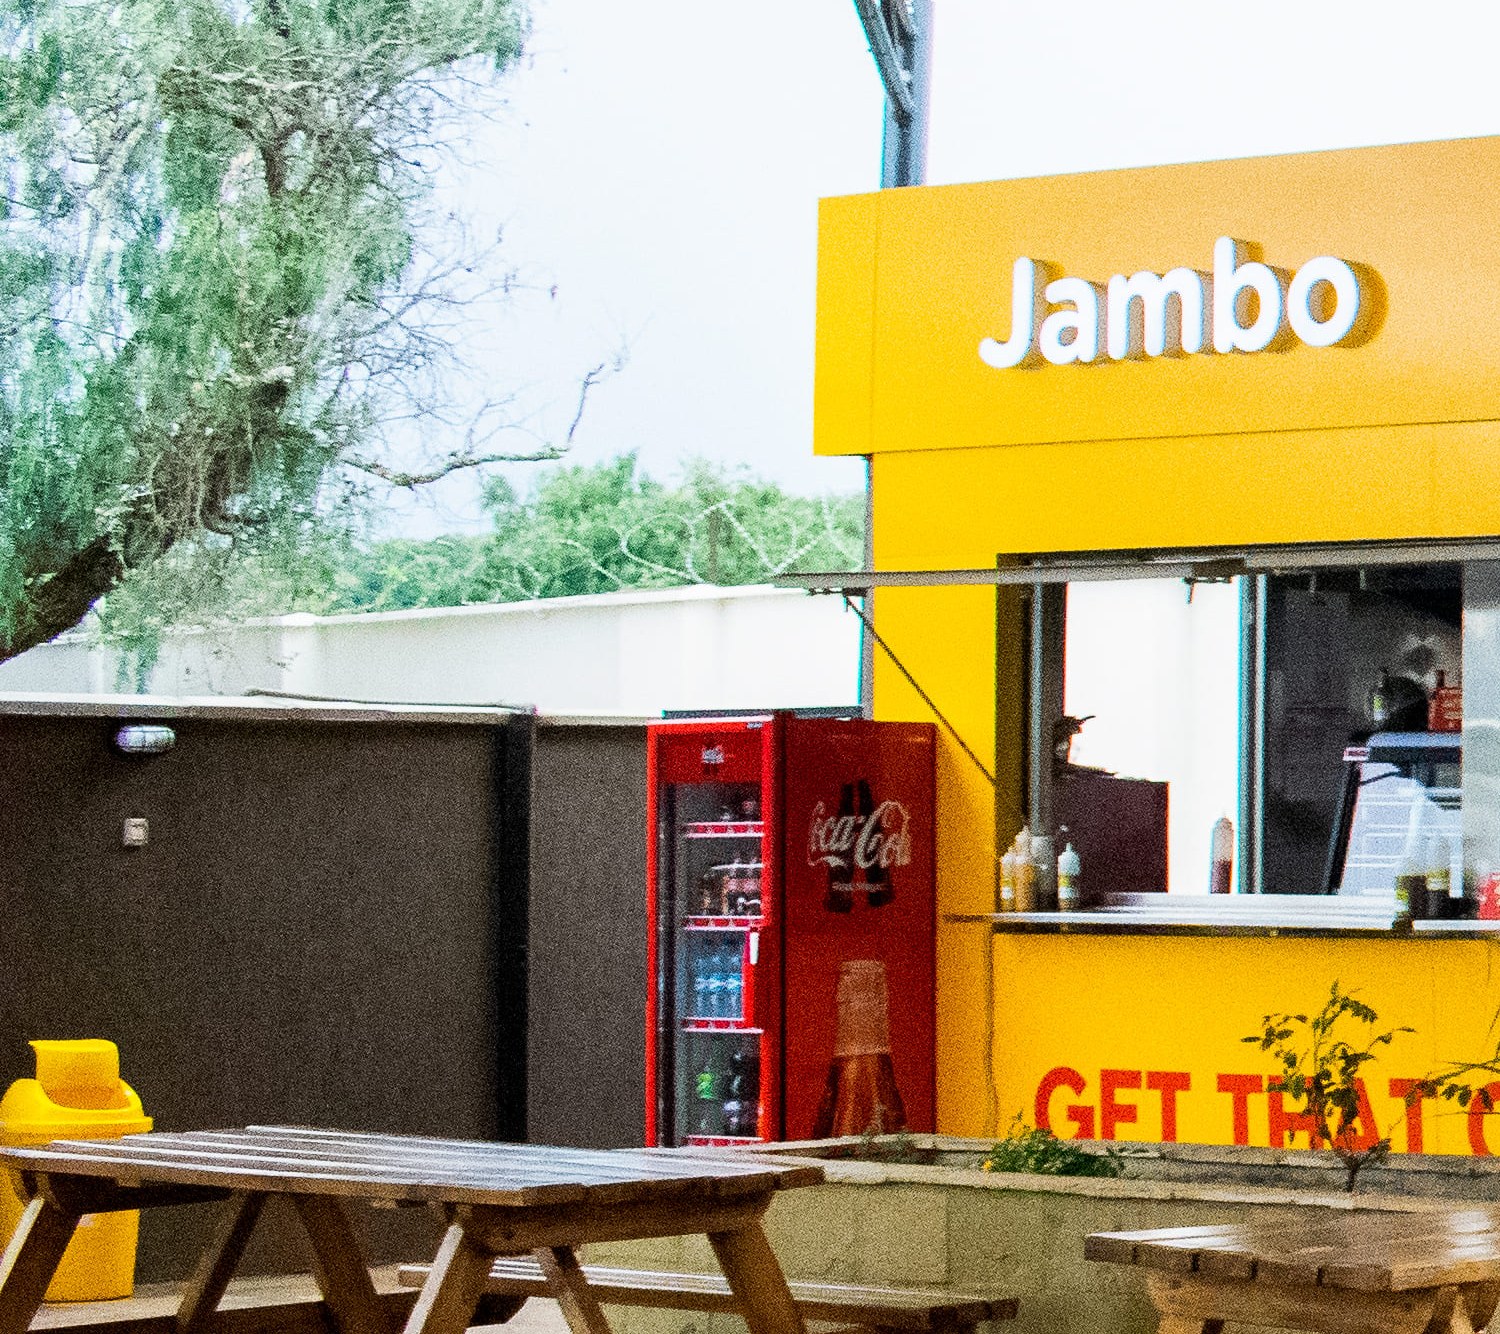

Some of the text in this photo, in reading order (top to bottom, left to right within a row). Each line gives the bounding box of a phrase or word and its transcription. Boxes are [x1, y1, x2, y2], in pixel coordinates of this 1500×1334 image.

[978, 235, 1361, 369] Jambo
[1034, 1066, 1192, 1143] GET
[1216, 1073, 1437, 1155] THAT
